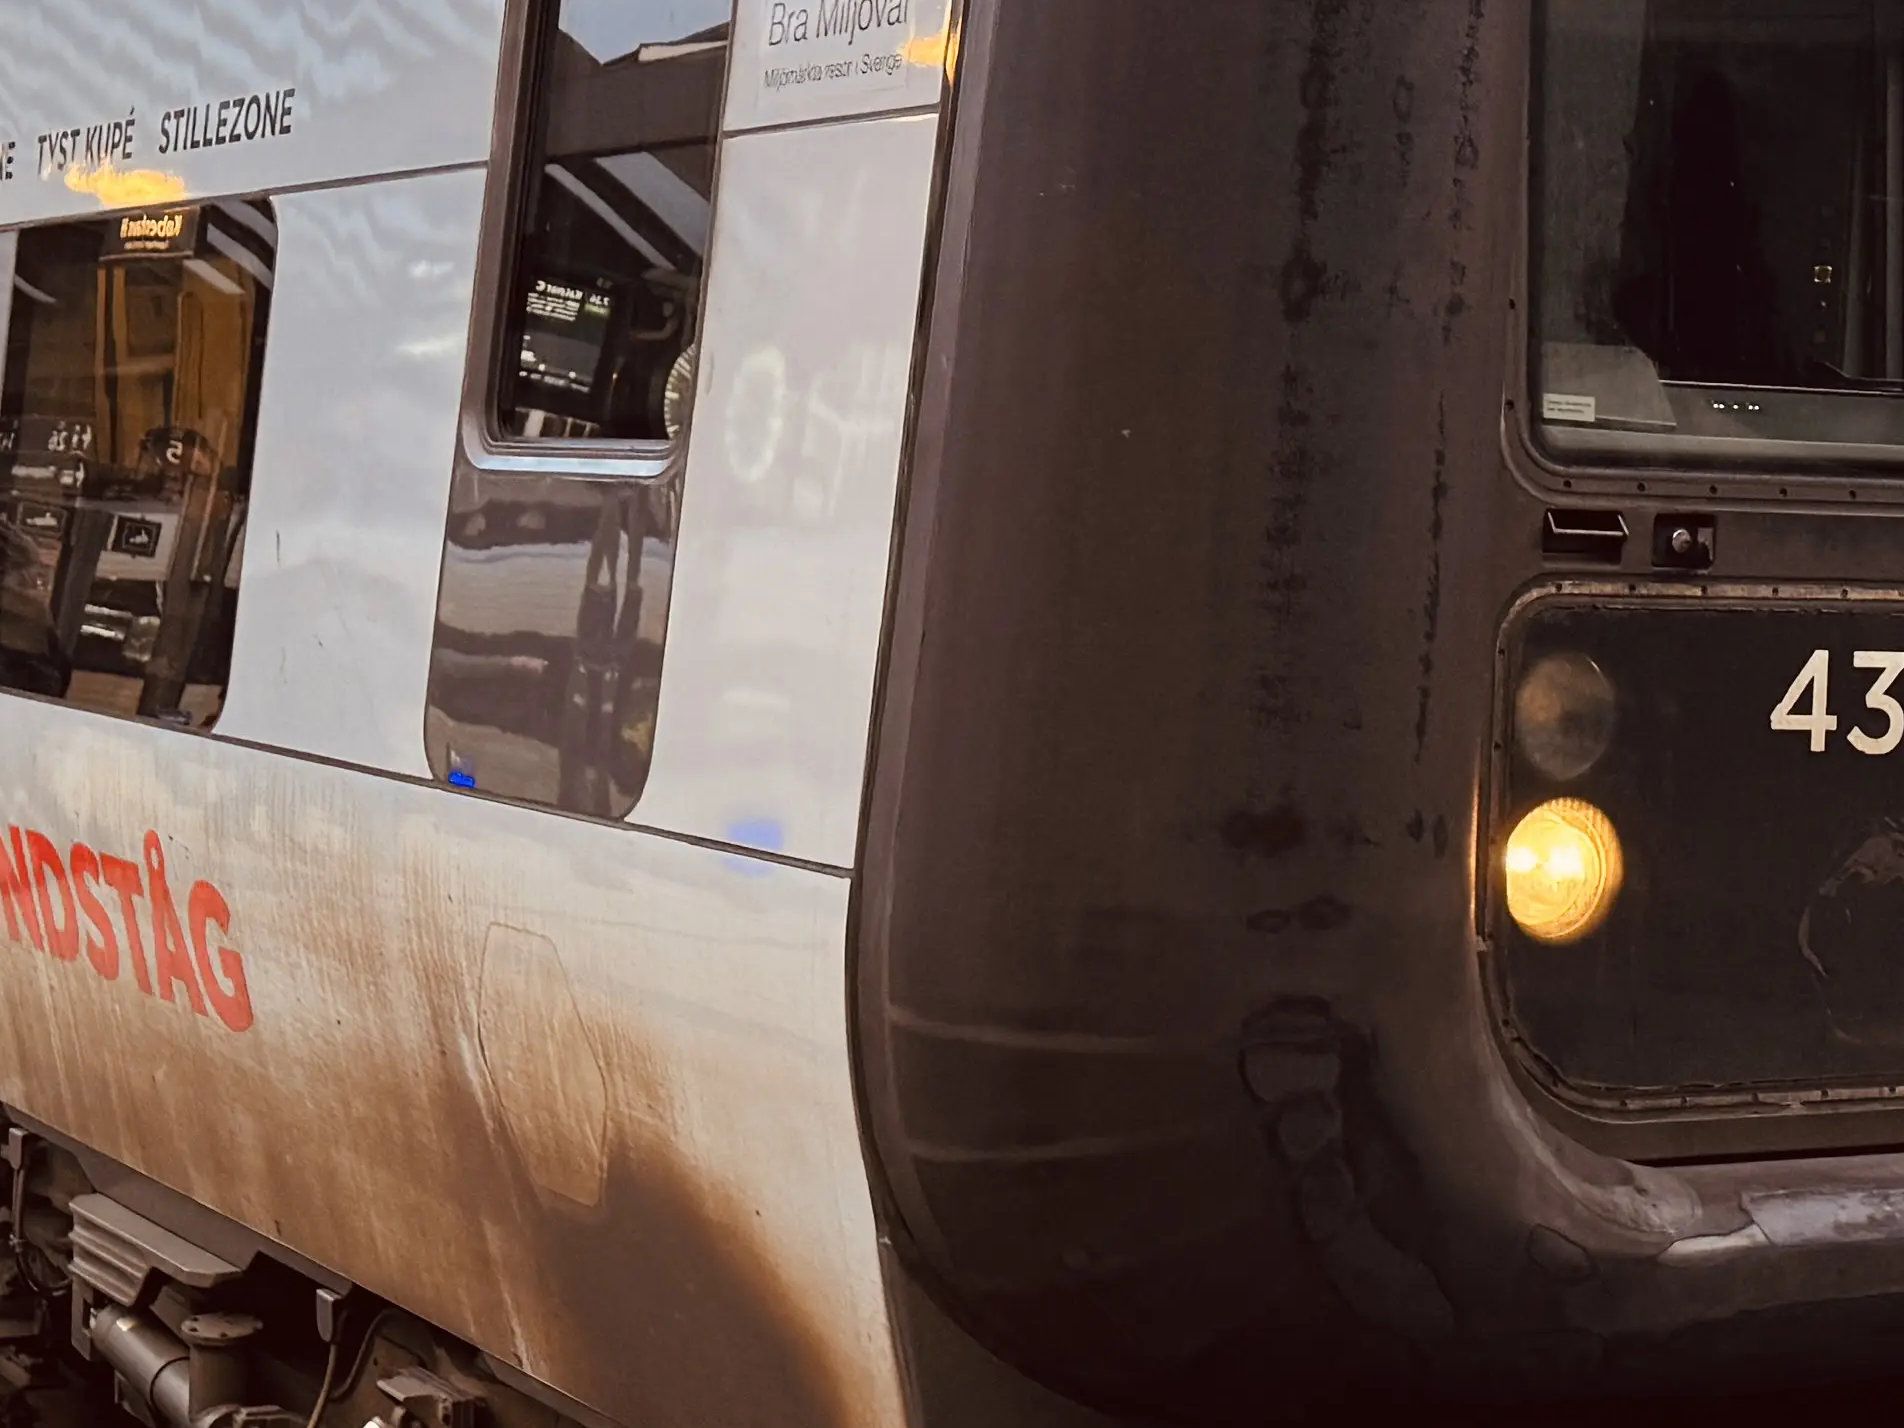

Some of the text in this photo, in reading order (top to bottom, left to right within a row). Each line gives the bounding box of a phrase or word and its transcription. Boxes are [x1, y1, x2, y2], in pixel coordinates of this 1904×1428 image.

[768, 1, 809, 47] Bra
[38, 128, 81, 175] TYST
[84, 105, 136, 172] KUPÉ
[158, 88, 296, 155] STILLEZONE
